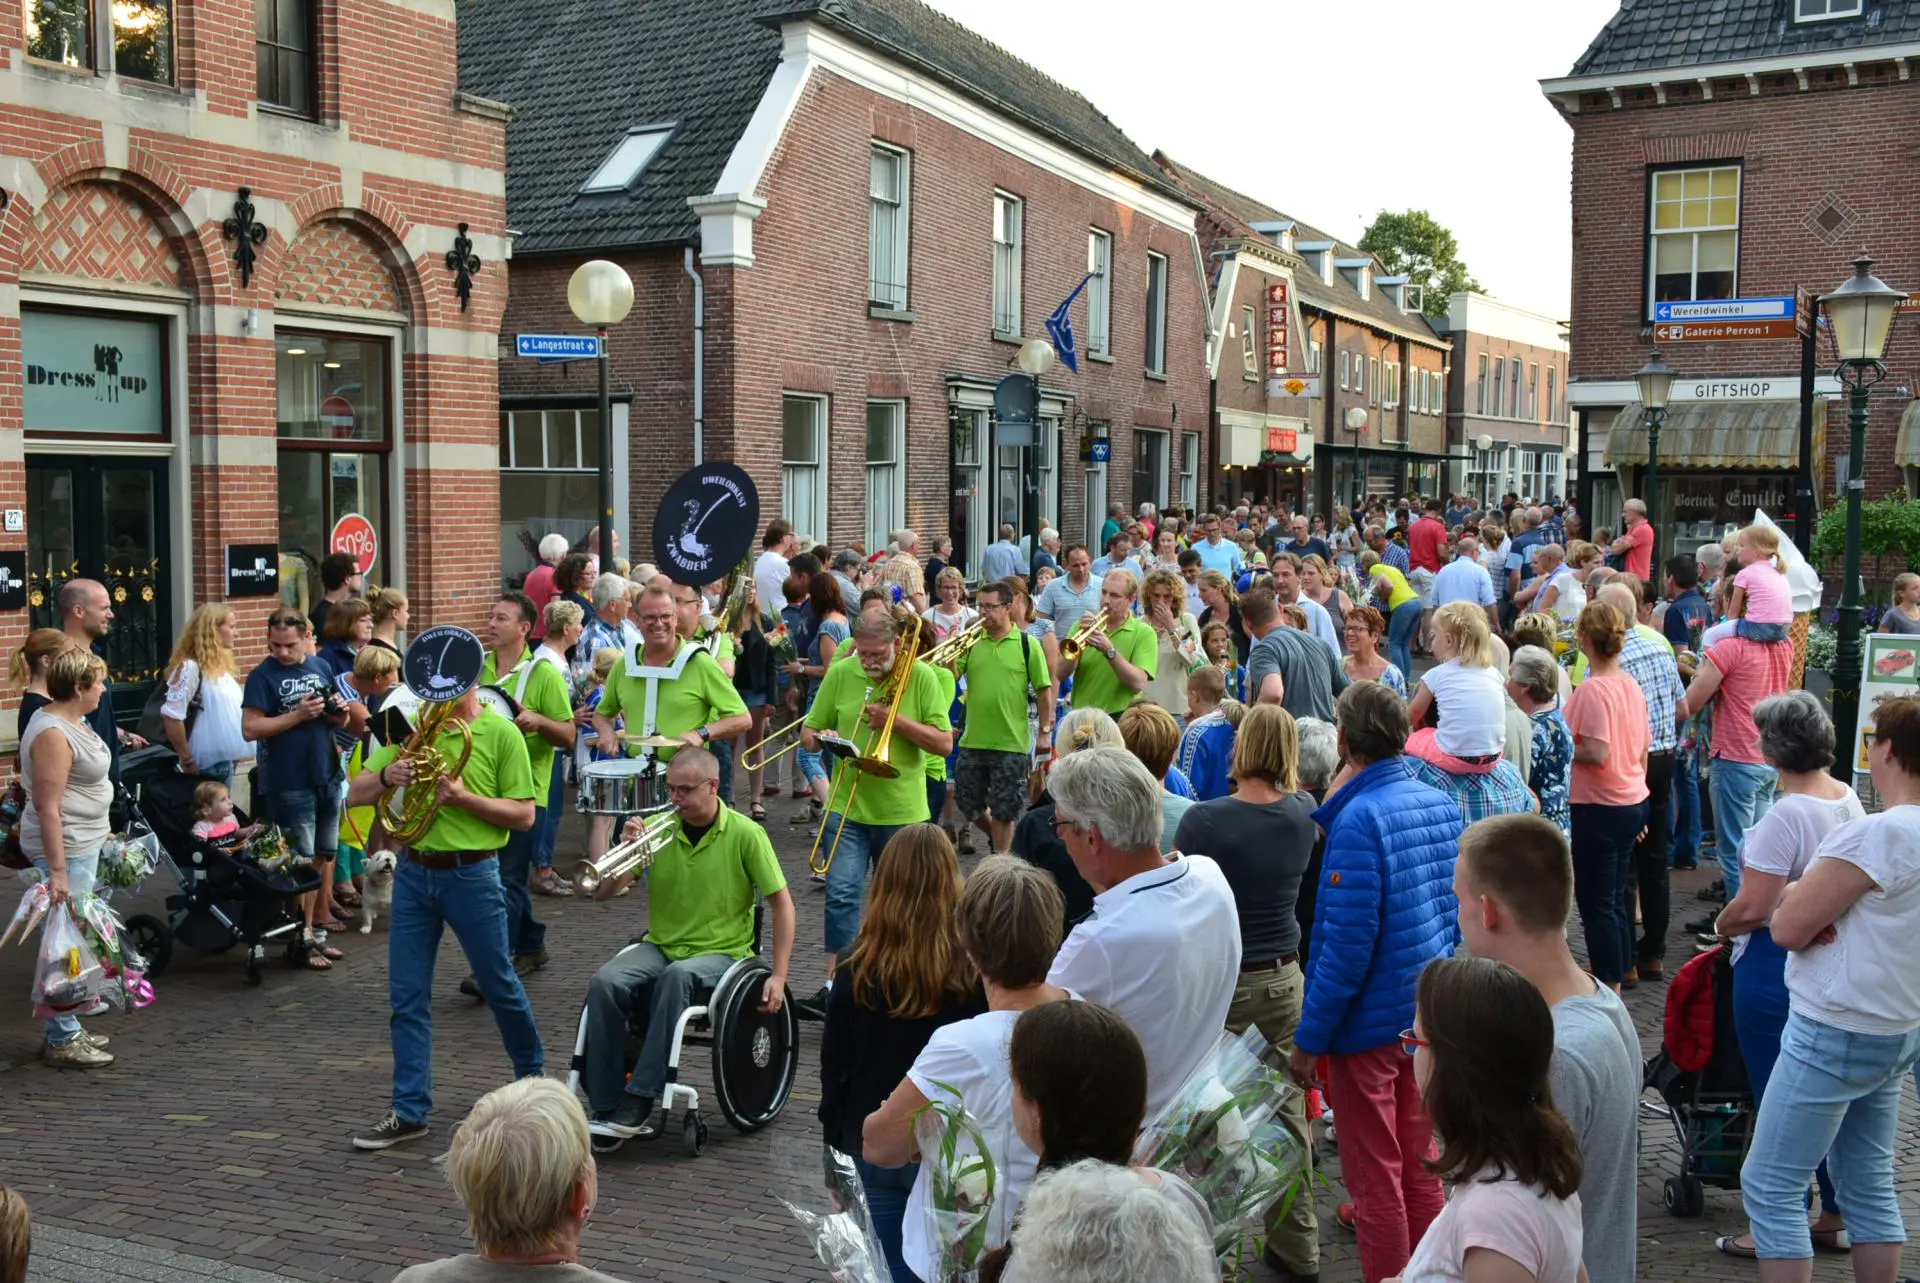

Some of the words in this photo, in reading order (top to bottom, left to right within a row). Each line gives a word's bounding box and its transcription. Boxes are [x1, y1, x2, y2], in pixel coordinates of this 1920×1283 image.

[1672, 305, 1744, 316] Wereldwinkel
[1685, 327, 1723, 337] Galerie
[1725, 326, 1761, 336] Perron
[1764, 326, 1769, 335] 1
[531, 338, 585, 352] Langestraat
[27, 364, 96, 388] Dress
[120, 376, 147, 394] up
[1695, 383, 1770, 397] GIFTSHOP
[702, 475, 747, 508] DWEILORKEST
[336, 528, 374, 556] 50%
